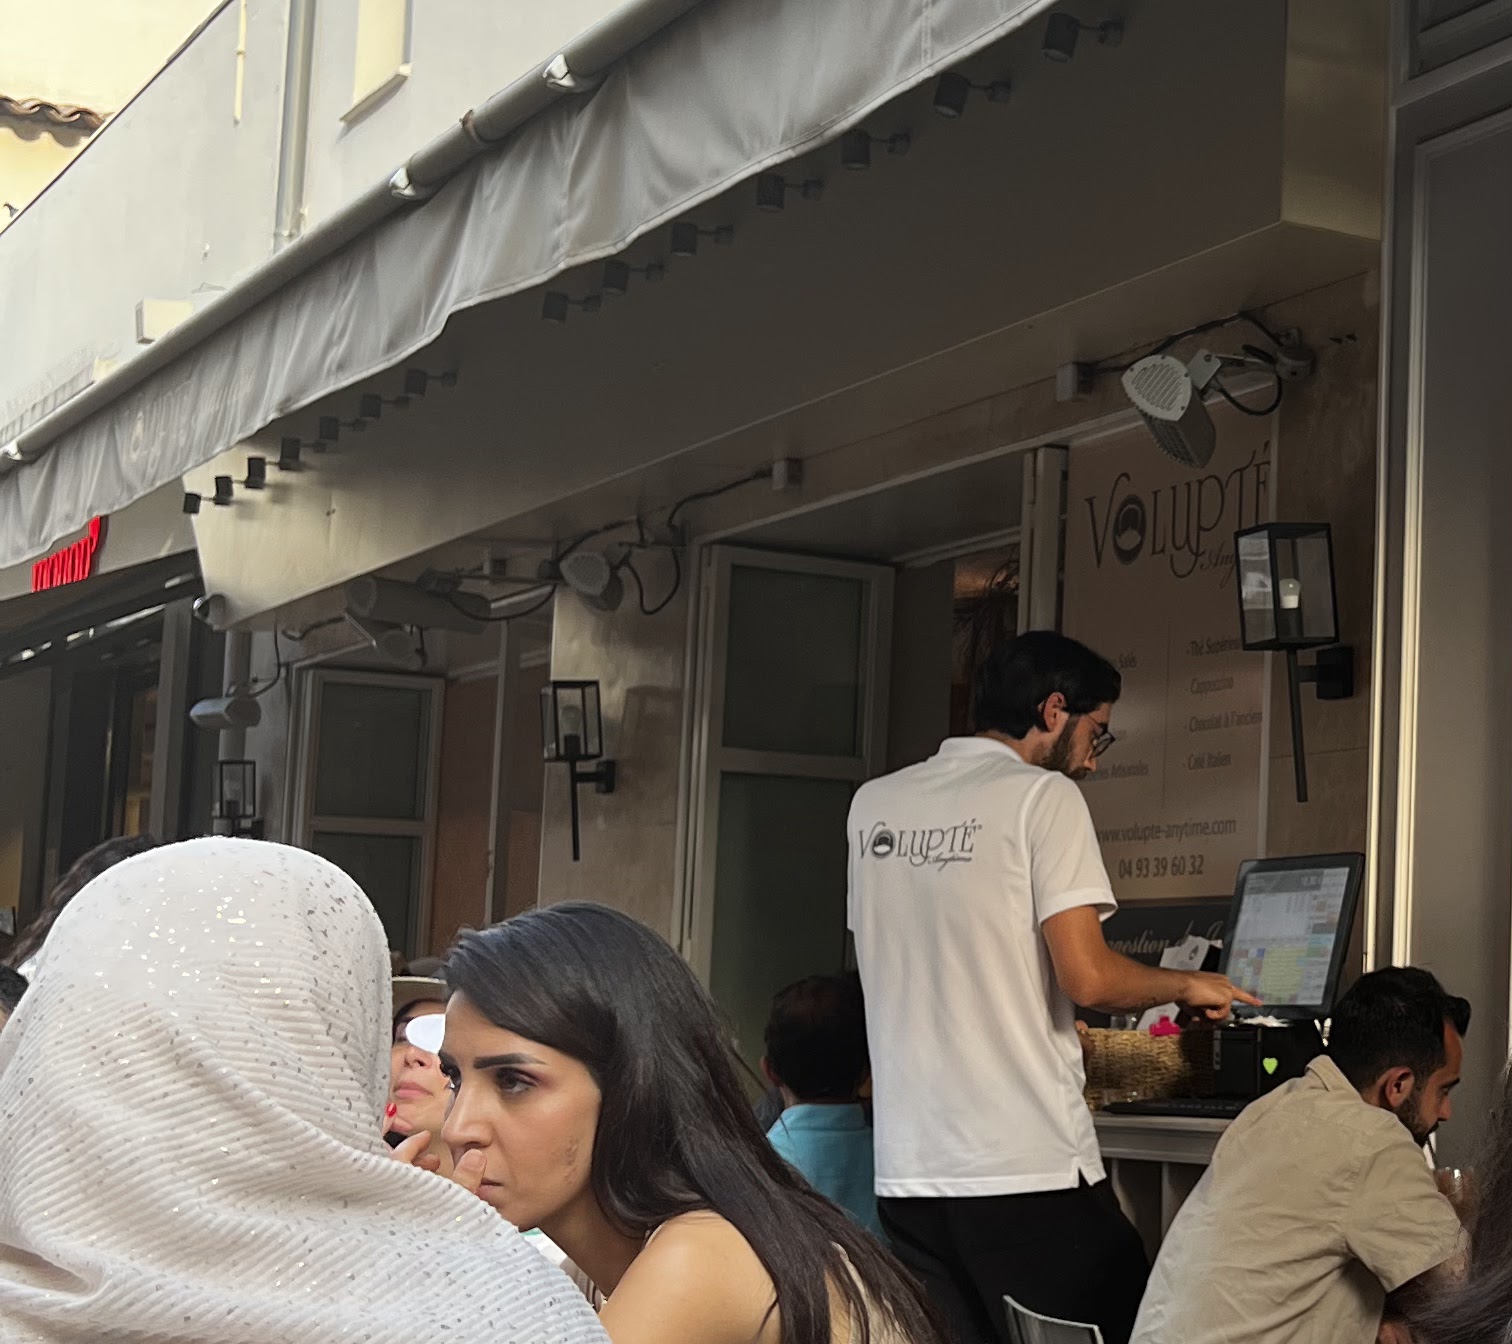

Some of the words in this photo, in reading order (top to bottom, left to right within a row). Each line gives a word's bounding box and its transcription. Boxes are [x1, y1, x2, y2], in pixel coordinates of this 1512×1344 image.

[1083, 440, 1271, 579] VOLUPTÉ
[1119, 857, 1133, 880] 04
[1136, 856, 1150, 879] 93
[1152, 856, 1168, 878] 39
[1171, 854, 1186, 877] 60
[1188, 853, 1204, 876] 32
